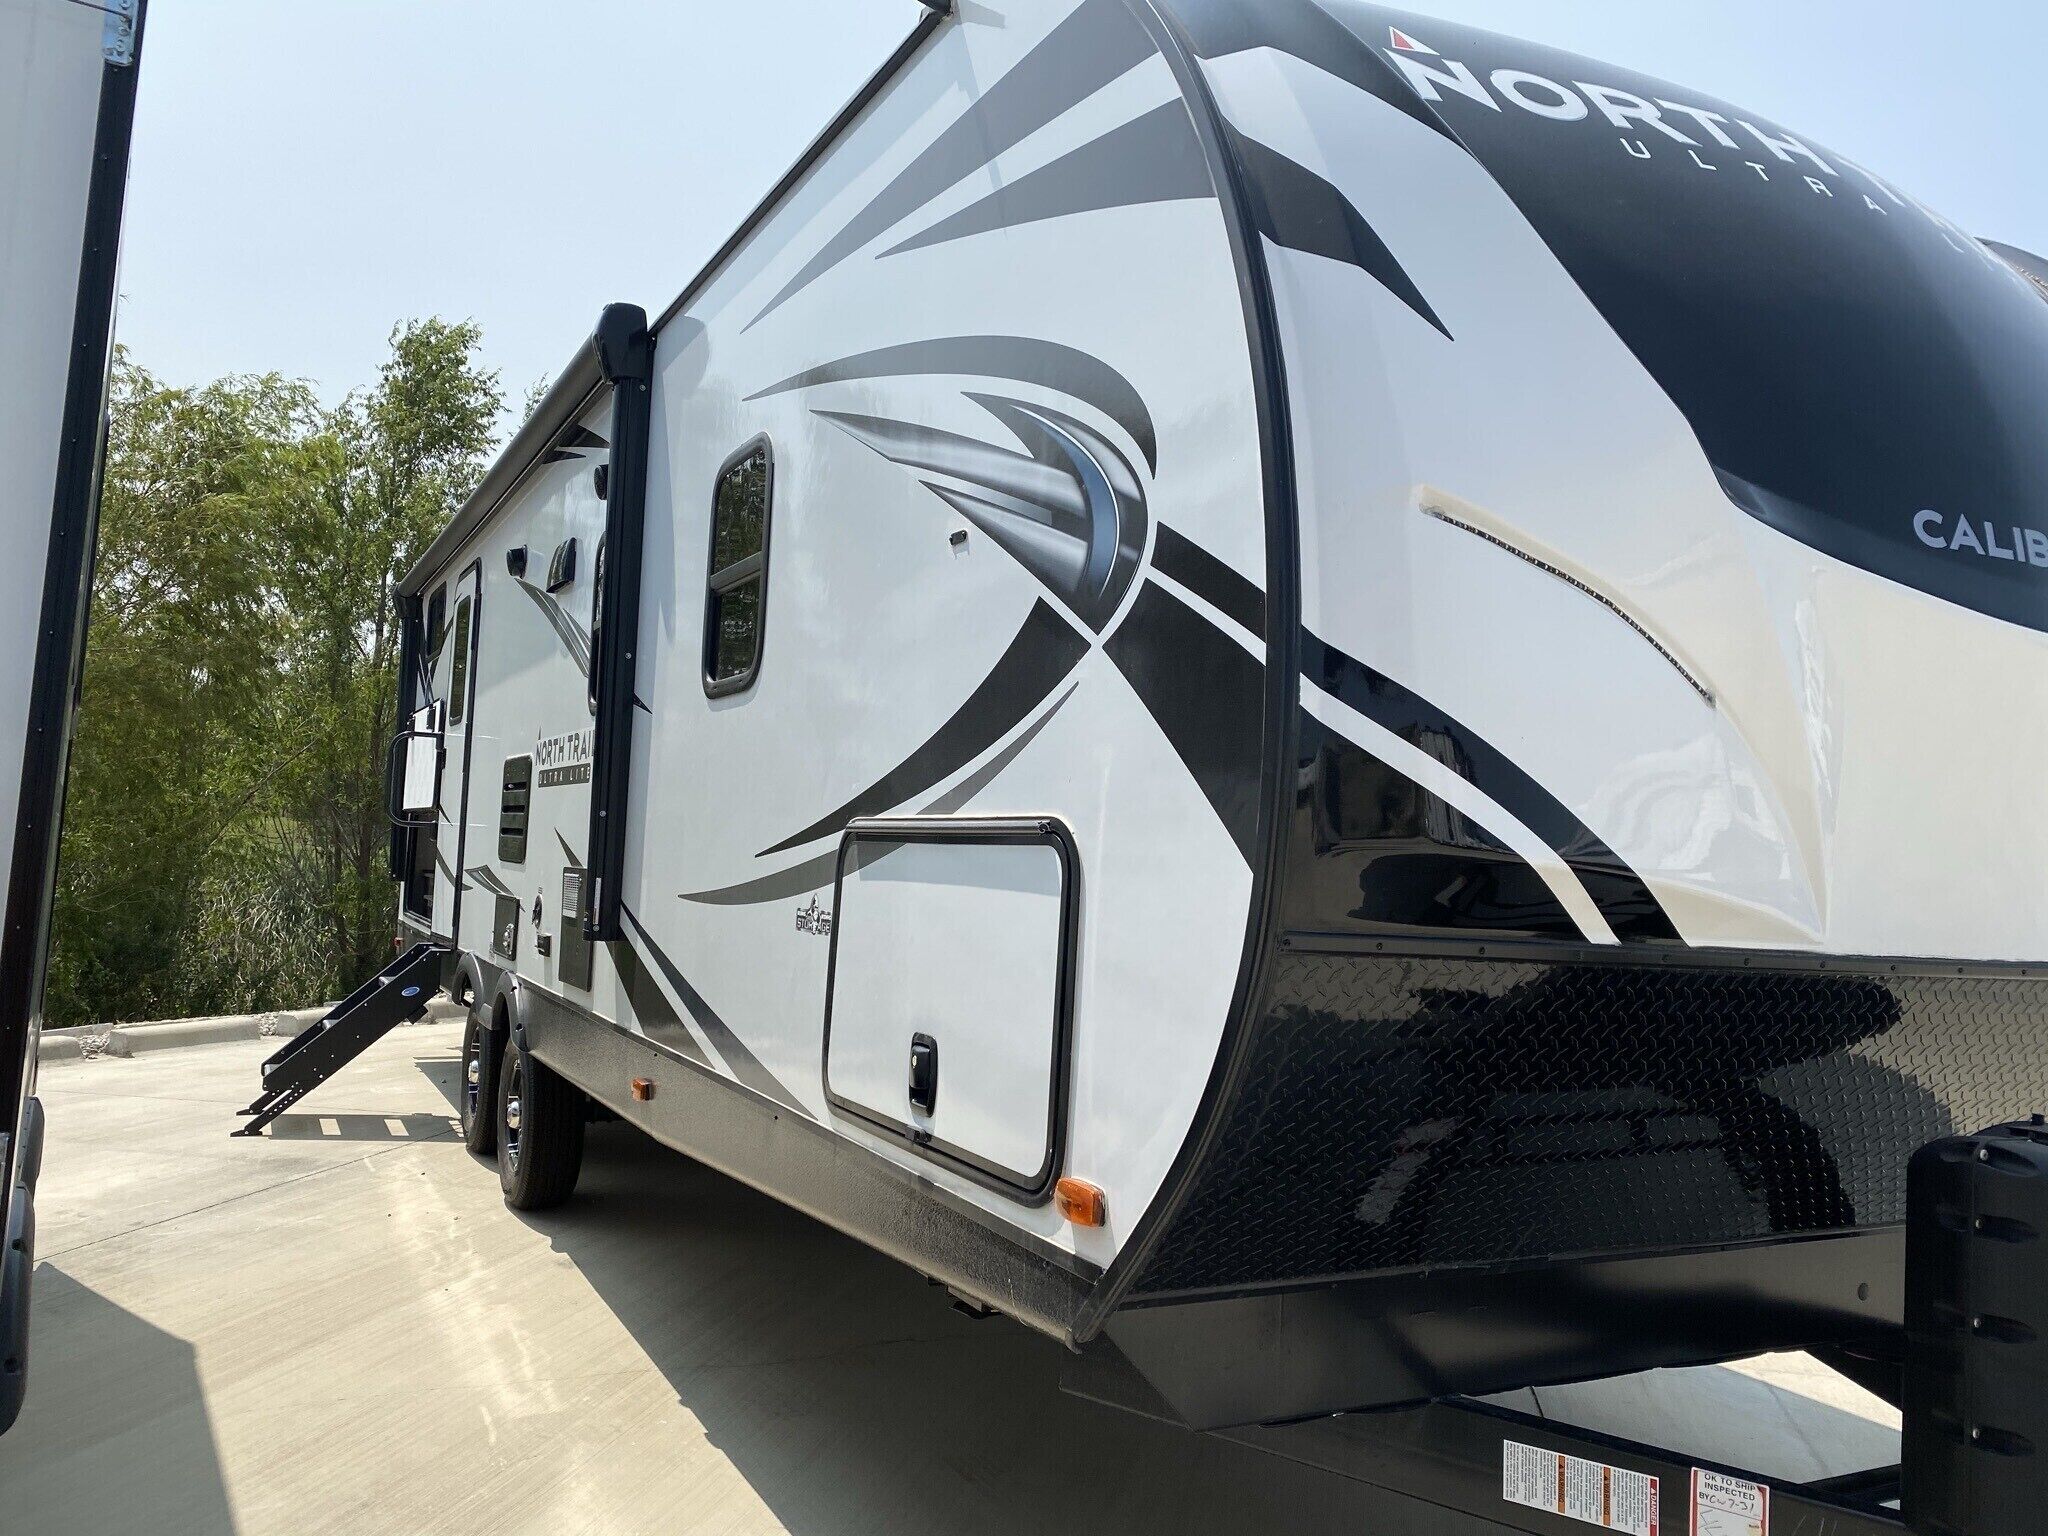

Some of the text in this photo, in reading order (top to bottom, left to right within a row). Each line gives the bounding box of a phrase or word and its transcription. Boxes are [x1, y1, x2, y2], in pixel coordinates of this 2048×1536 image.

[1382, 47, 1841, 178] NORTH
[1619, 137, 1888, 216] ULTRA
[1913, 508, 2048, 568] CALIB
[535, 737, 566, 767] NORTH
[539, 766, 590, 784] ULTRA LITE
[1704, 1473, 1756, 1492] OK TO SHIP
[1704, 1481, 1756, 1502] INSPECTED
[1698, 1491, 1710, 1501] BY
